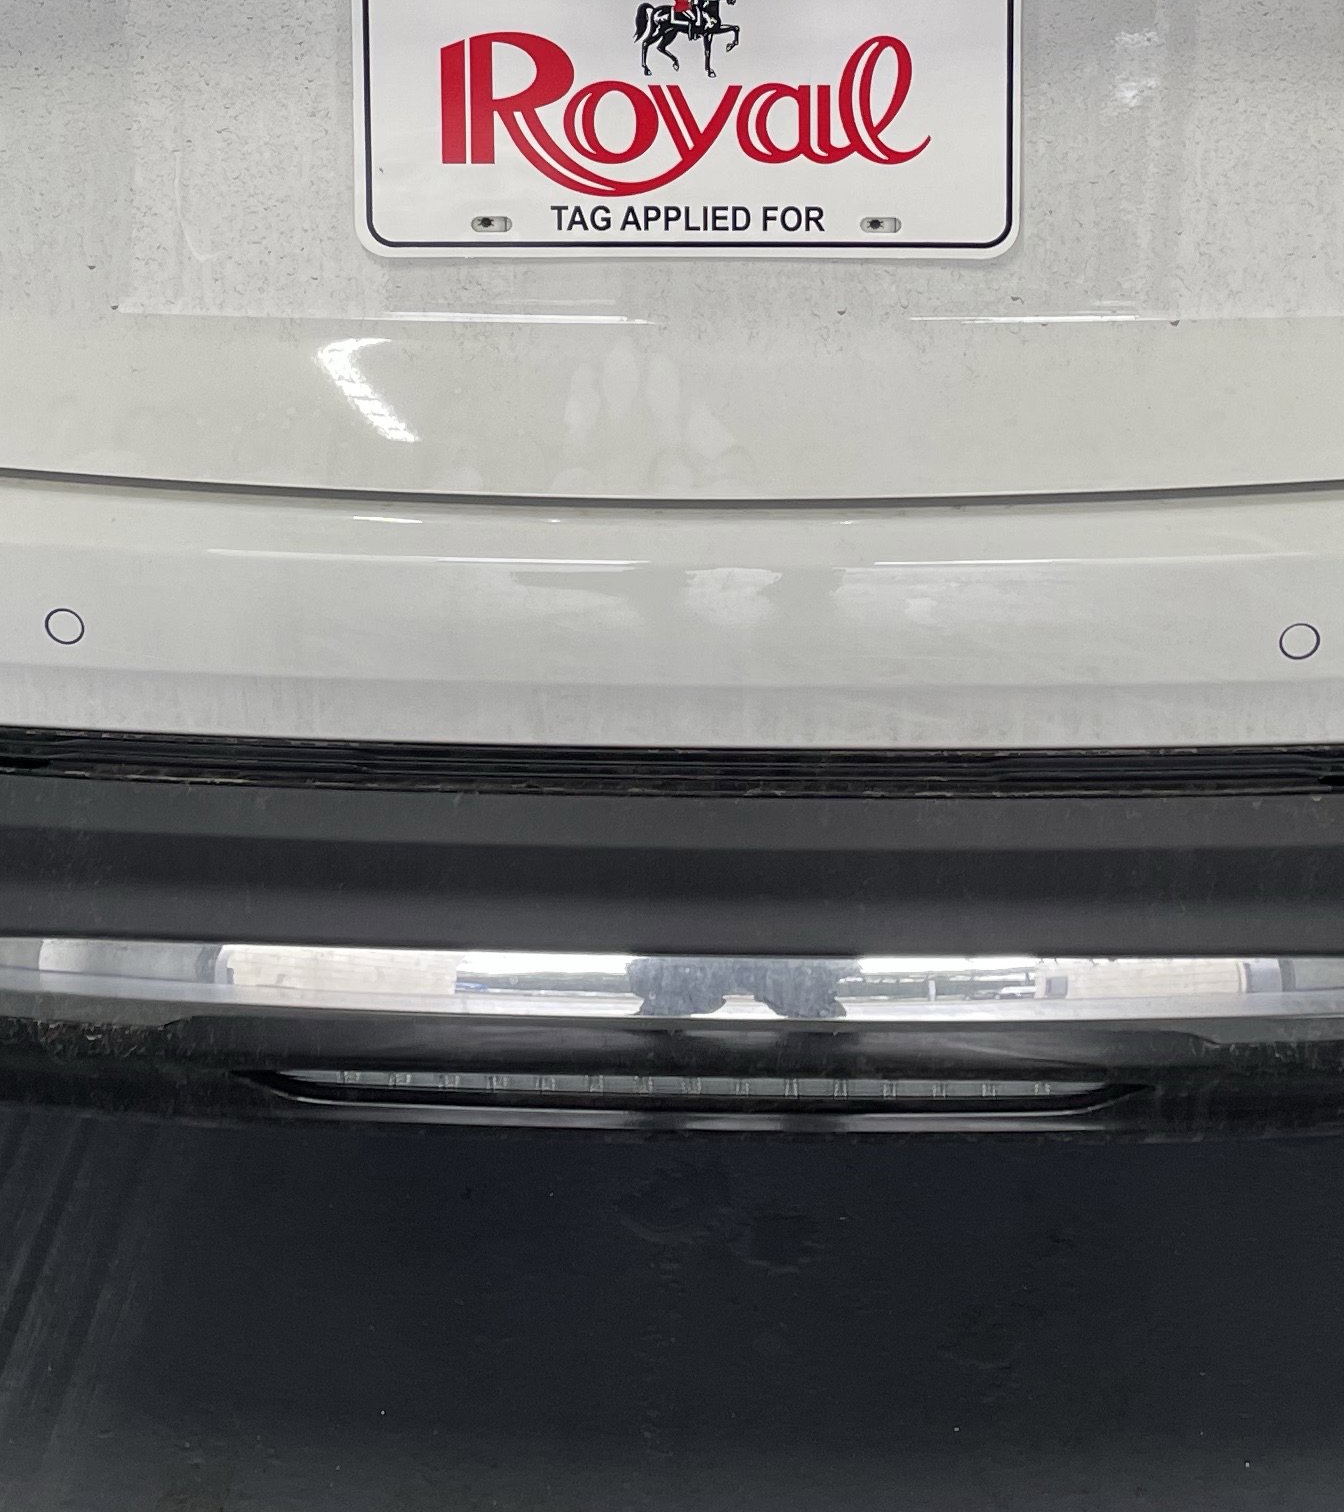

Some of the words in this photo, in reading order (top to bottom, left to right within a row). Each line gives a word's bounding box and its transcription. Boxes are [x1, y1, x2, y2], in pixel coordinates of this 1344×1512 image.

[440, 31, 932, 198] Royal
[551, 205, 613, 233] TAG
[620, 205, 751, 233] APPLIED
[762, 205, 826, 233] FOR
